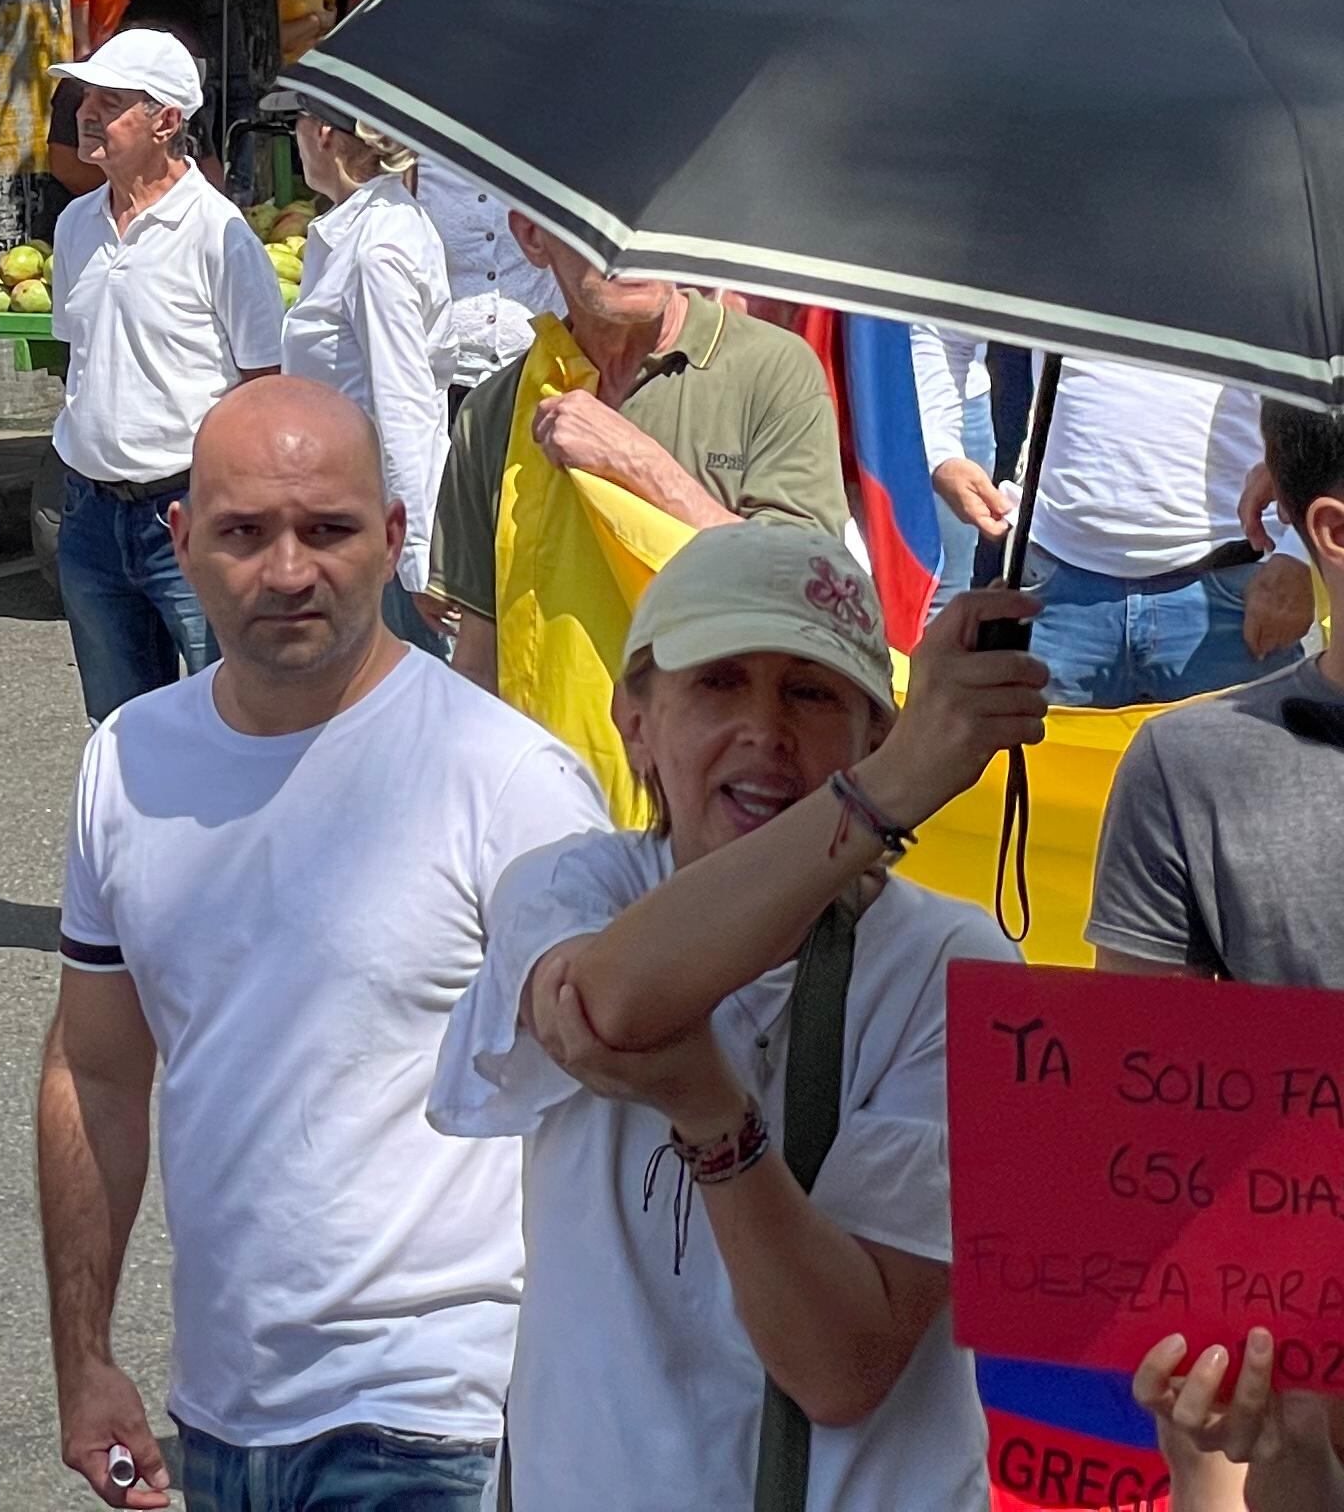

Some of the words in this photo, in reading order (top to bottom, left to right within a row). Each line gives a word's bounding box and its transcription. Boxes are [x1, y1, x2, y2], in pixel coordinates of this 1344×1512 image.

[1118, 1050, 1256, 1113] SOLO
[1270, 1066, 1344, 1130] FA
[1108, 1143, 1216, 1209] 656
[1247, 1167, 1344, 1223] DIA
[967, 1232, 1192, 1314] FUERZA
